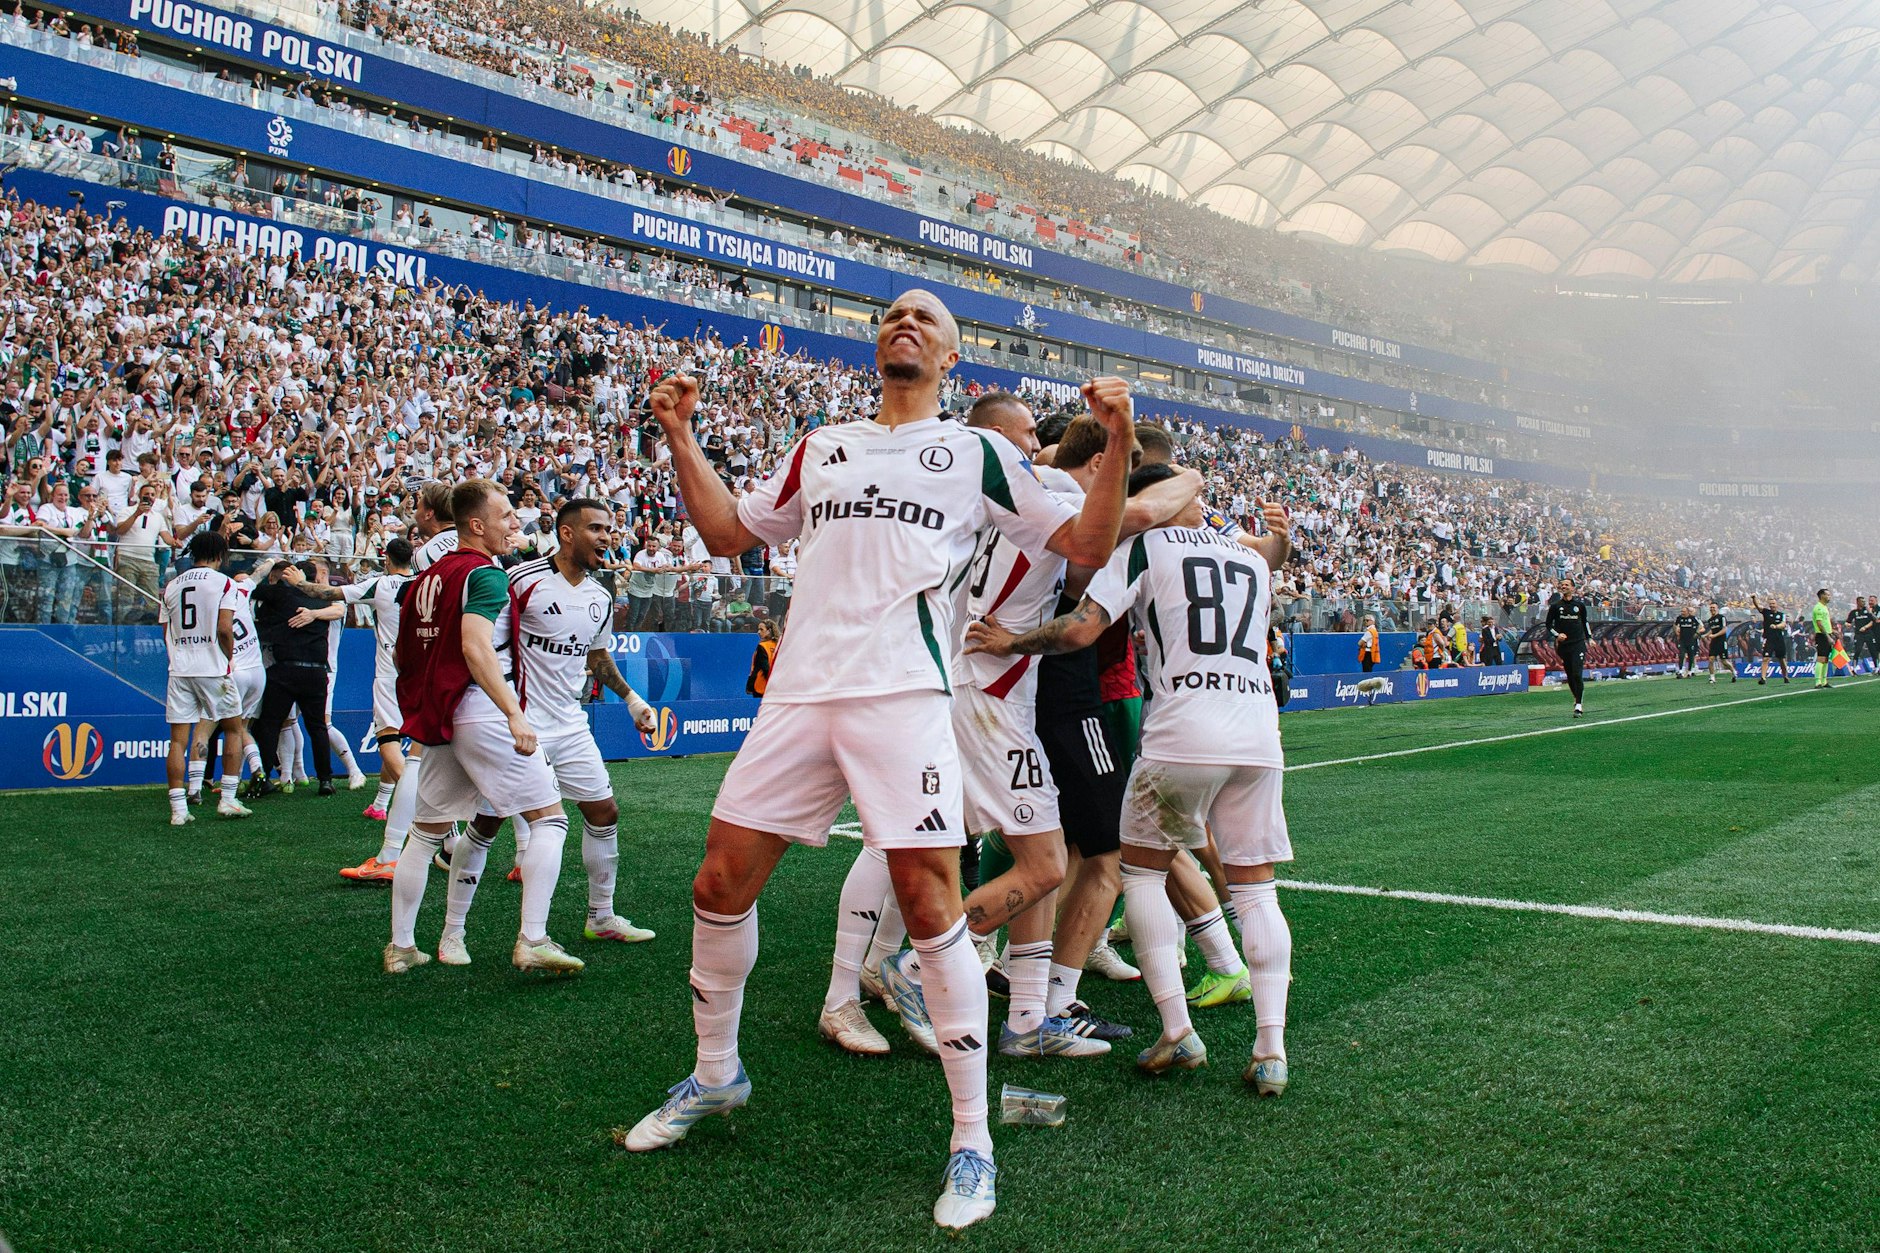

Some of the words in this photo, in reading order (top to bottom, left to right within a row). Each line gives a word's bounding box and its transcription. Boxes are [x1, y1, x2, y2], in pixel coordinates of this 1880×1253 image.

[130, 0, 253, 52] PUCHAR
[262, 30, 362, 83] POLSKI
[268, 146, 289, 157] PZPN
[164, 206, 303, 262] PUCHAR
[315, 237, 427, 288] POLSKI
[632, 212, 701, 249] PUCHAR
[706, 231, 773, 267] TYSIĄCA
[777, 248, 836, 281] DRUŻYN
[920, 219, 978, 254] PUCHAR
[983, 237, 1033, 268] POLSKI
[1332, 329, 1368, 352] PUCHAR
[1370, 338, 1400, 359] POLSKI
[1197, 348, 1233, 371] PUCHAR
[1235, 357, 1272, 380] TYSIĄCA
[1273, 365, 1305, 385] DRUŻYN
[1428, 450, 1462, 470] PUCHAR
[1464, 455, 1493, 474] POLSKI
[811, 497, 945, 530] Plus500
[181, 586, 196, 630] 6
[1182, 556, 1259, 664] 82
[1172, 671, 1273, 695] FORTUNA
[683, 718, 729, 735] PUCHAR
[732, 717, 758, 733] POL
[114, 740, 172, 759] PUCH
[1007, 748, 1043, 791] 28
